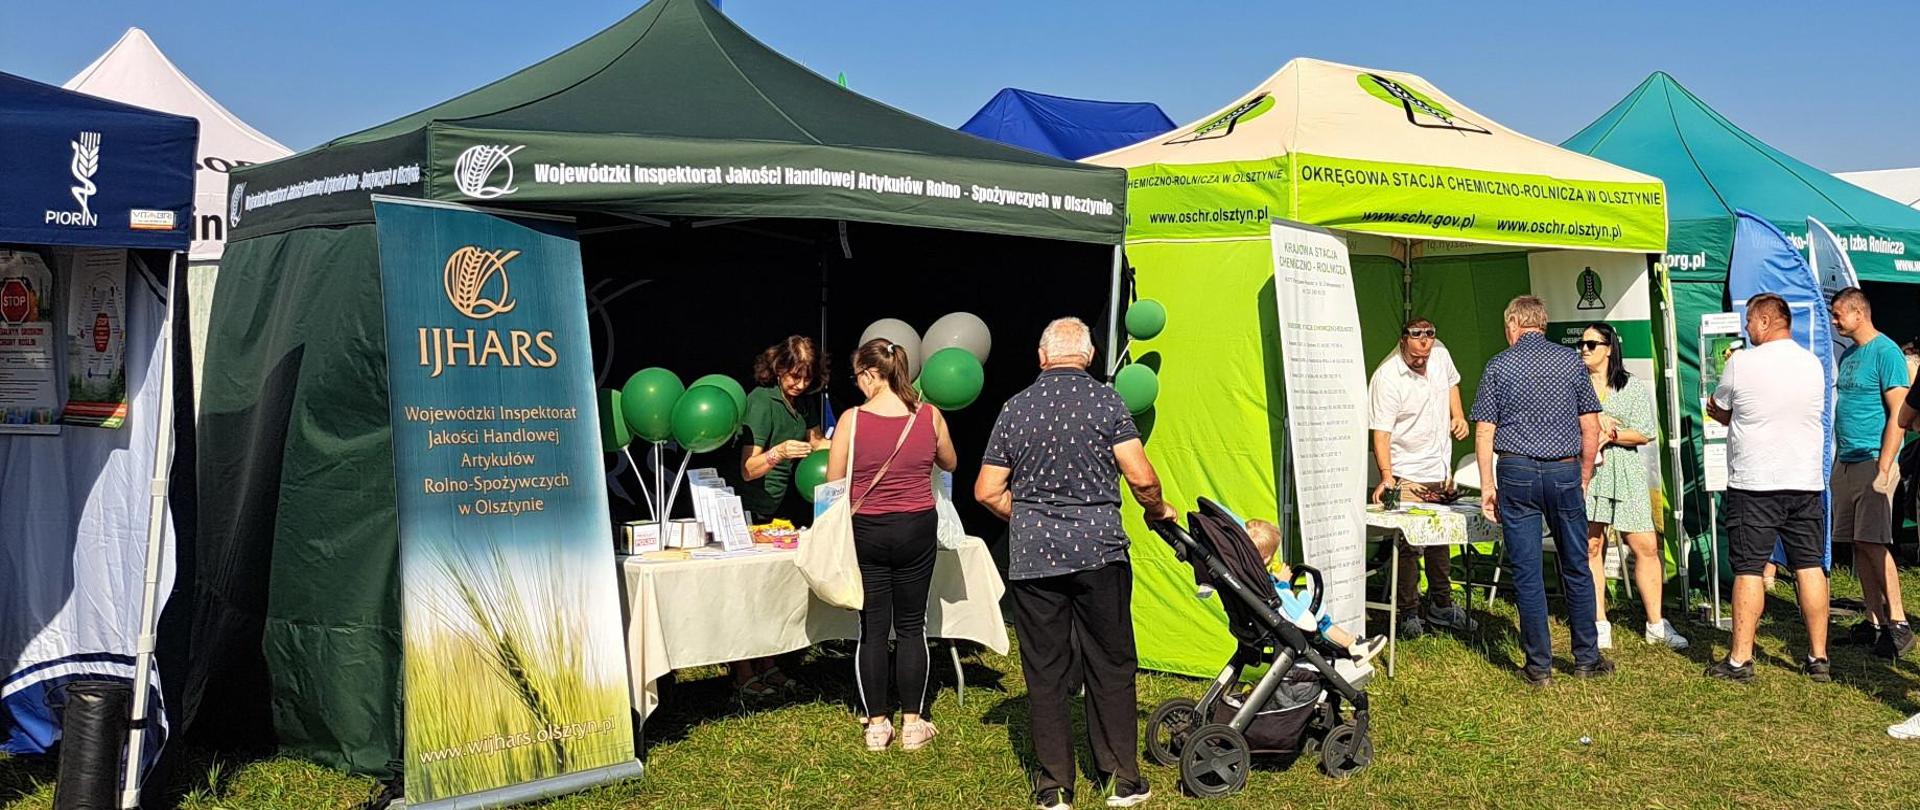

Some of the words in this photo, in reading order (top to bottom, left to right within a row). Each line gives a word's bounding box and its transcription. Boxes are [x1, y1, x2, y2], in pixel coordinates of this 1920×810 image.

[1127, 175, 1219, 189] HEMICZNO-ROLNICZA
[1222, 174, 1230, 183] W
[1233, 169, 1283, 183] OLSZTYNIE
[1301, 165, 1390, 187] OKRĘGOWA
[1393, 172, 1445, 189] STACJA
[1447, 176, 1584, 202] CHEMICZNO-ROLNICZA
[1586, 190, 1596, 202] W
[1599, 190, 1661, 206] OLSZTYNIE
[535, 163, 631, 185] Wojewódzki
[634, 165, 723, 185] Inspektorat
[726, 166, 782, 185] Jakości
[785, 168, 855, 189] Handlowej
[858, 172, 923, 195] Artykułów
[926, 180, 961, 199] Rolno
[971, 184, 1049, 208] Spożywczych
[1051, 197, 1061, 209] w
[1064, 195, 1114, 216] Olsztynie
[45, 211, 98, 226] PIORIN
[1150, 206, 1269, 224] www.oschr.olsztyn.pl
[1361, 210, 1476, 231] www.schr.gov.pl
[1497, 219, 1622, 241] www.oschr.olsztyn.pl
[1284, 242, 1314, 256] KRAJOWA
[1315, 246, 1338, 260] STACJA
[1850, 234, 1868, 251] Izba
[1869, 235, 1905, 254] Rolnicza
[1667, 252, 1706, 270] org.pl
[3, 296, 26, 307] STOP
[418, 327, 558, 378] IJHARS
[404, 406, 495, 424] Wojewódzki
[500, 406, 577, 423] Inspektorat
[428, 429, 479, 449] Jakości
[483, 428, 560, 445] Handlowej
[461, 451, 535, 471] Artykułów
[424, 472, 569, 494] Rolno-Spożywczych
[458, 504, 471, 515] w
[475, 497, 544, 517] Olsztynie
[419, 715, 616, 764] www.wijhars.olsztyn.pl
